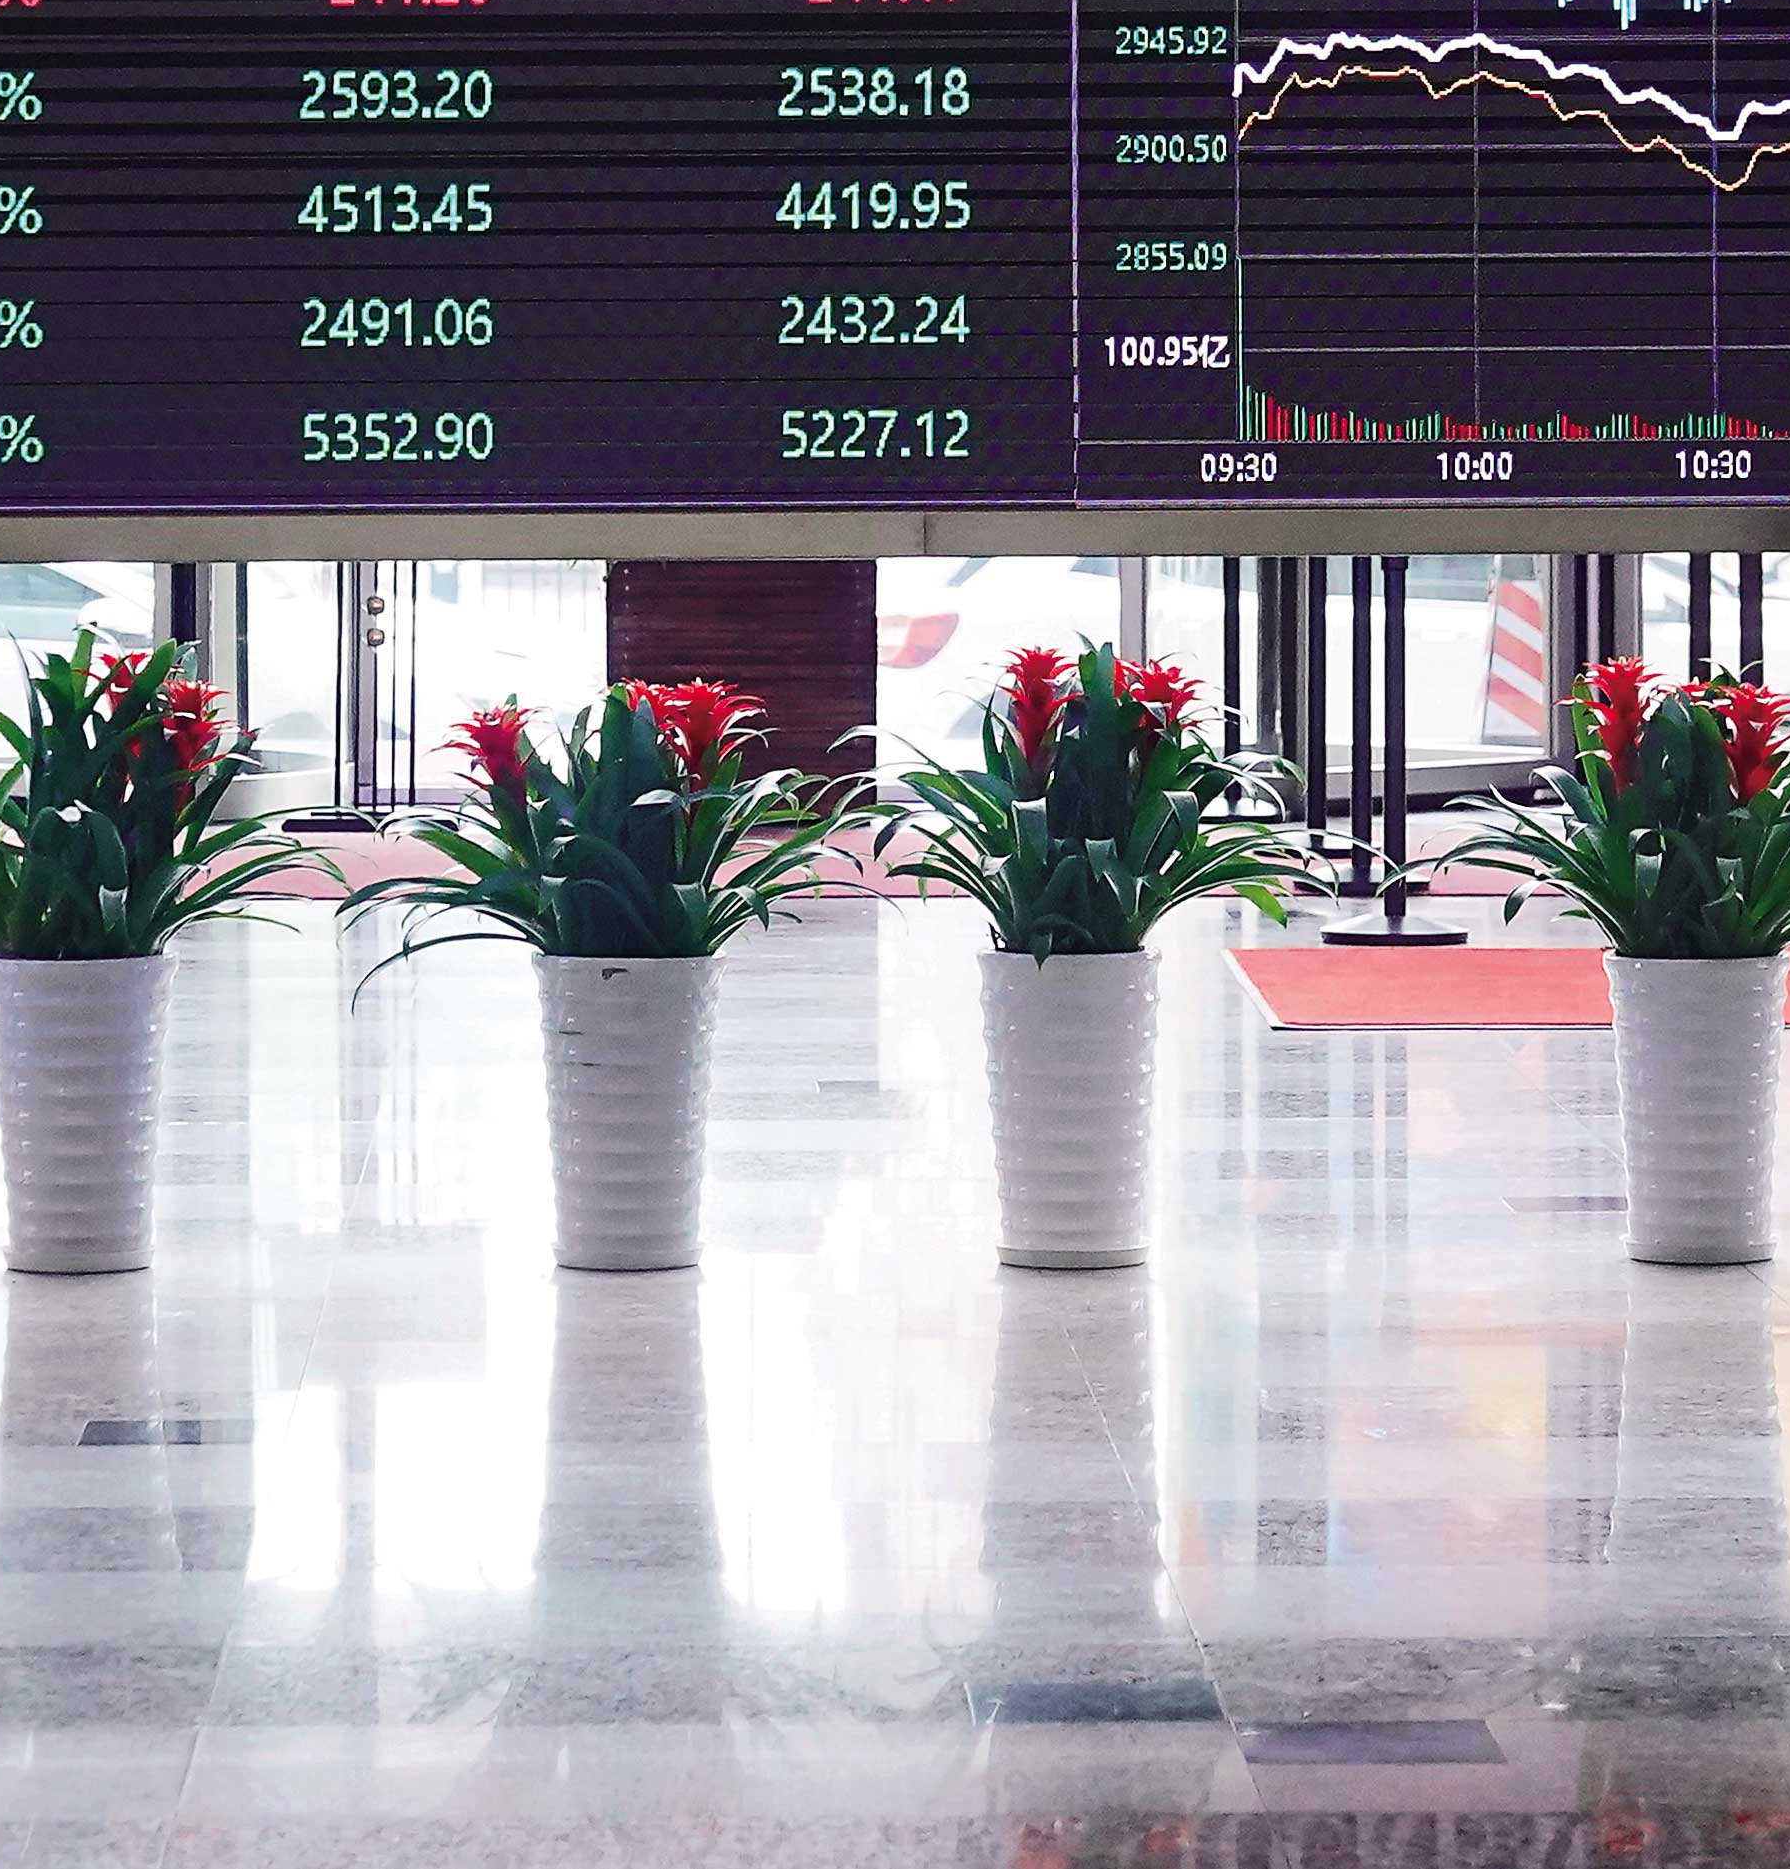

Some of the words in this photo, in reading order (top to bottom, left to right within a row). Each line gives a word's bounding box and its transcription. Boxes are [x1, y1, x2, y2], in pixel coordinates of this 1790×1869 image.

[1116, 26, 1226, 54] 2945.92
[1116, 134, 1226, 163] 2900.50
[298, 184, 492, 232] 4513.45
[776, 182, 970, 229] 4419.95
[1116, 241, 1226, 270] 2855.09
[1105, 335, 1230, 368] 100.95亿
[304, 413, 493, 460] 5352.90
[783, 410, 968, 457] 5227.12
[1201, 452, 1276, 482] 09:30
[1437, 452, 1512, 480] 10:00
[1676, 449, 1751, 478] 10:30
